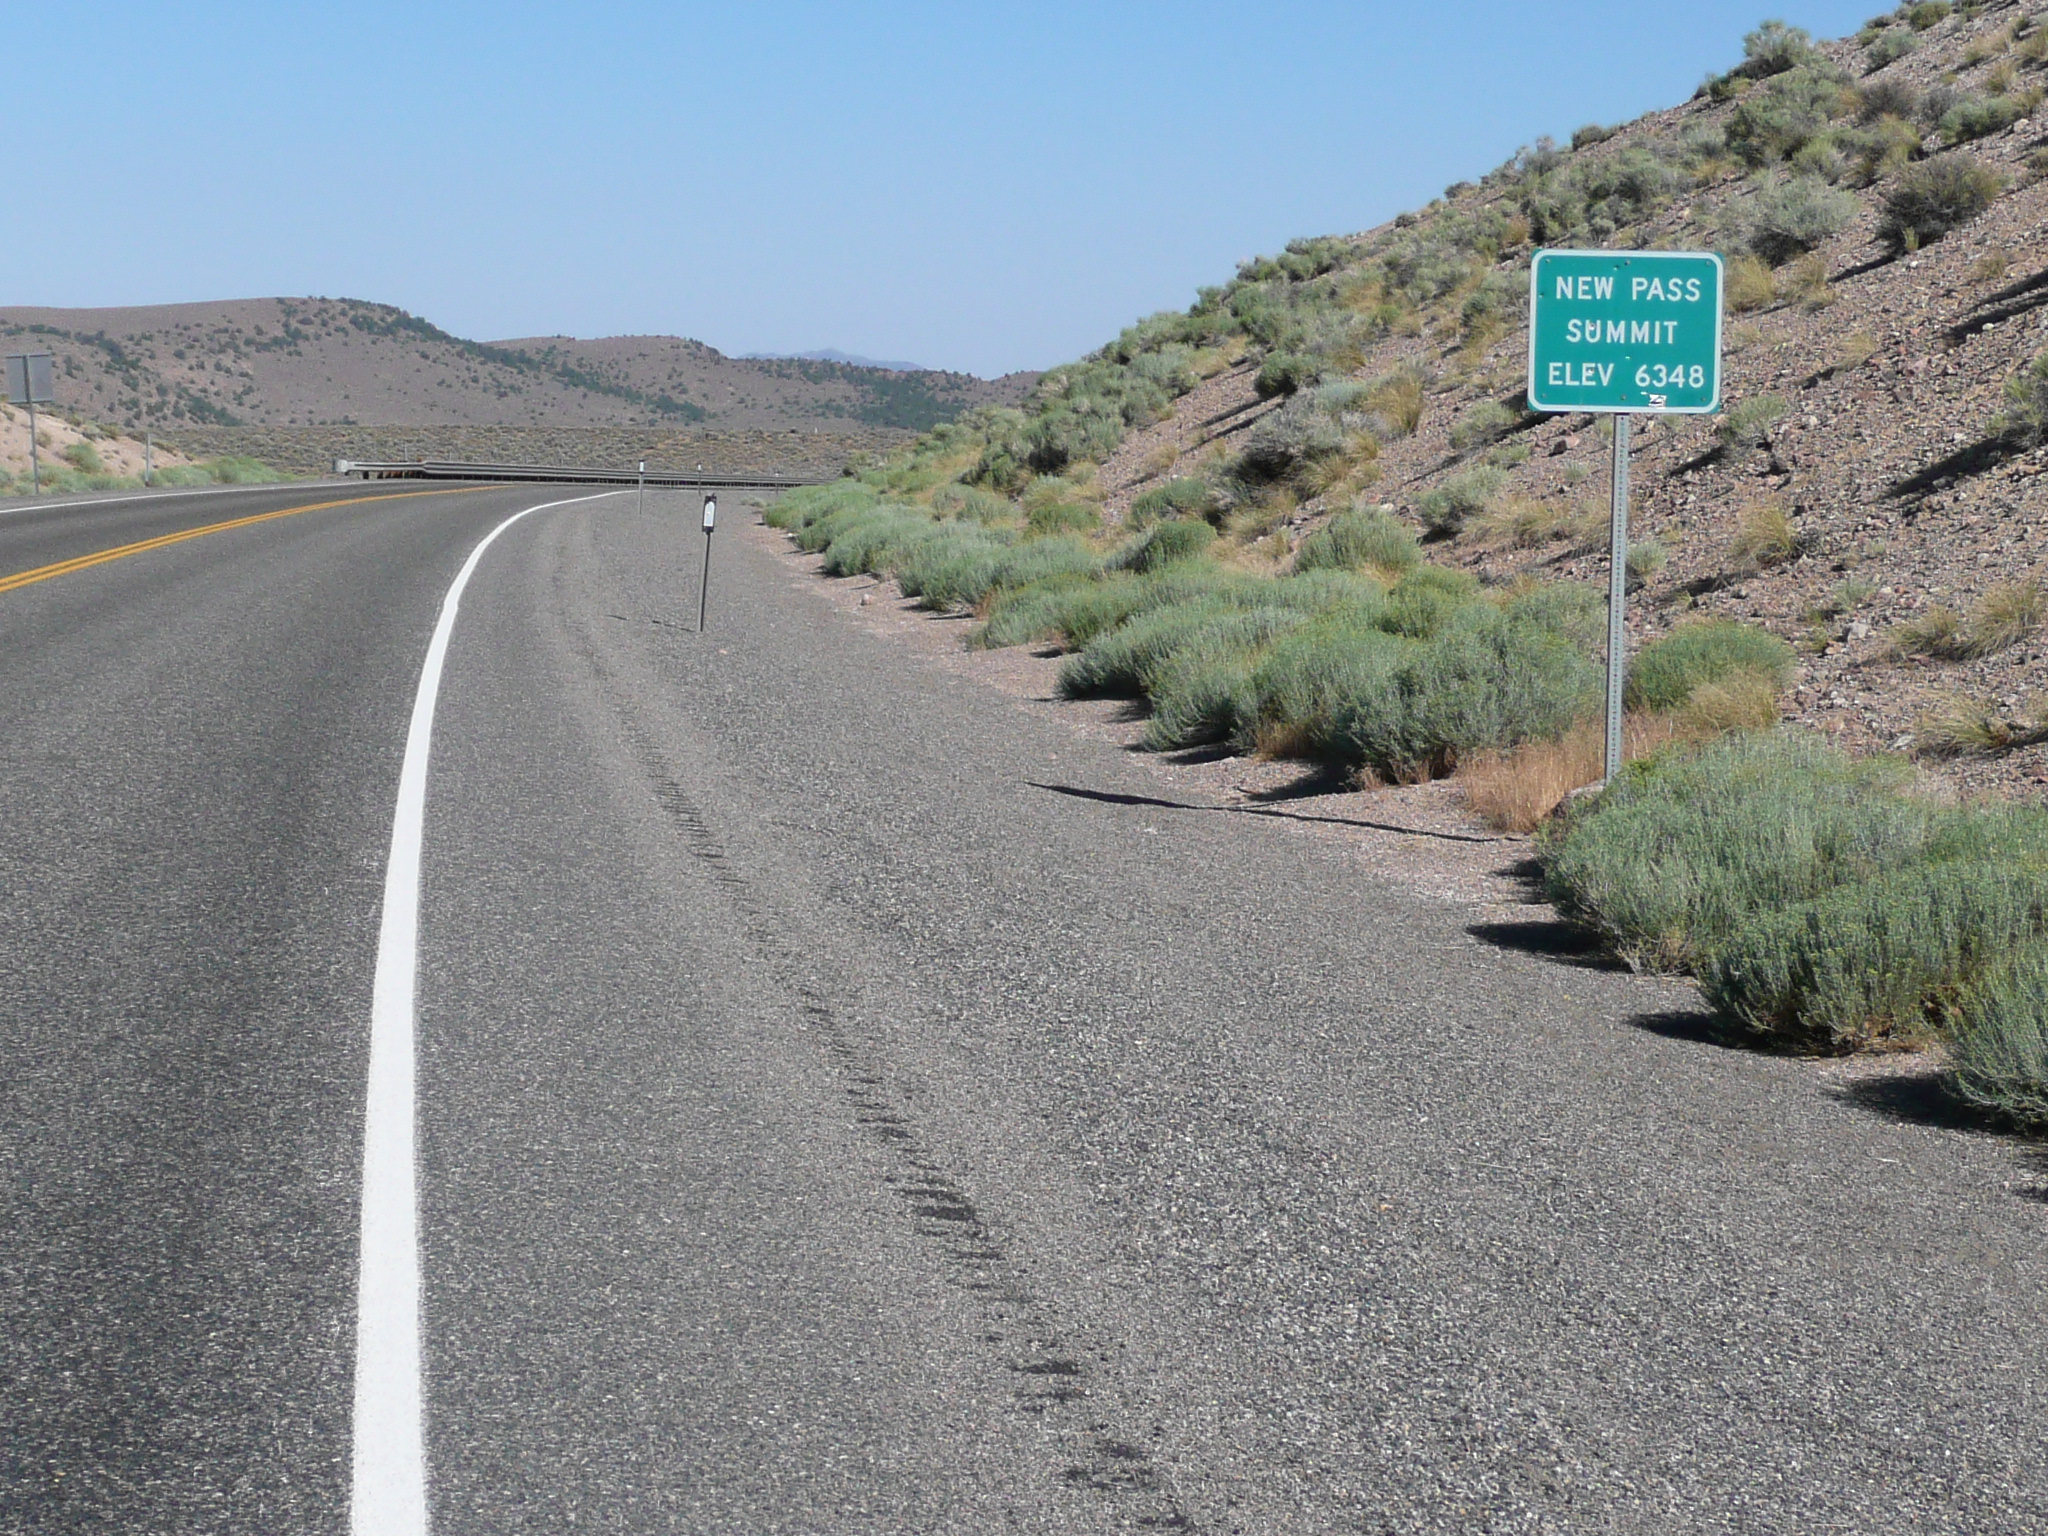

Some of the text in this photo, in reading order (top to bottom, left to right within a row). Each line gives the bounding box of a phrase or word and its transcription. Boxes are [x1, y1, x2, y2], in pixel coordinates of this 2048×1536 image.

[1556, 276, 1701, 302] NEW PASS
[1566, 318, 1678, 344] SUMMIT
[1549, 362, 1704, 388] ELEV 6348
